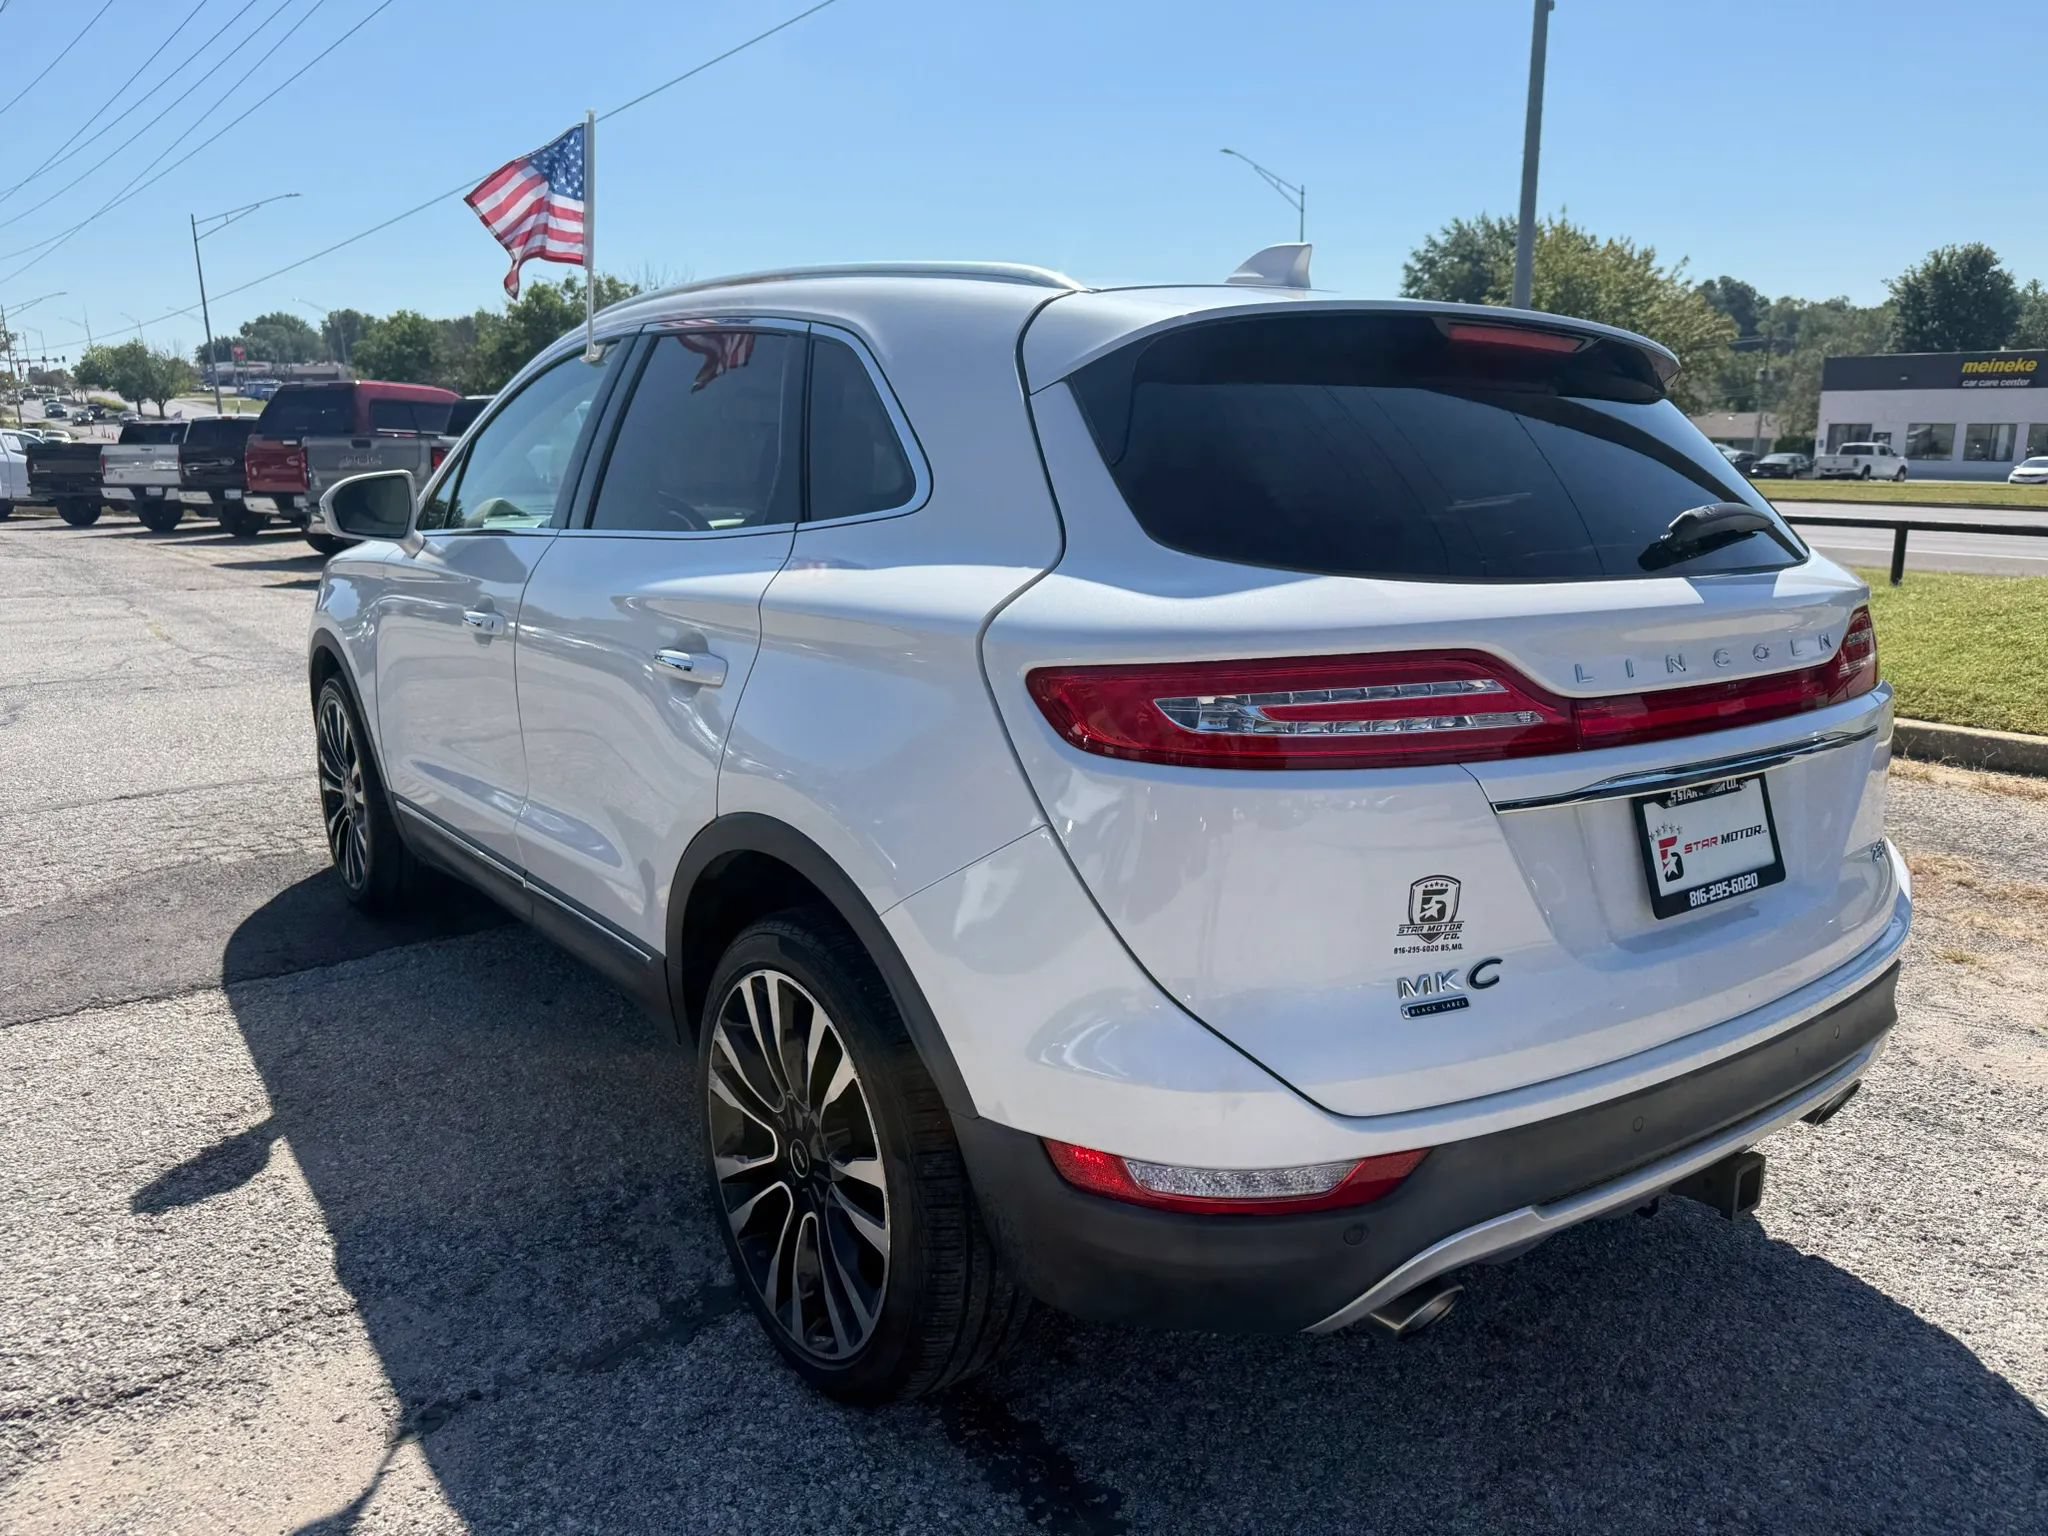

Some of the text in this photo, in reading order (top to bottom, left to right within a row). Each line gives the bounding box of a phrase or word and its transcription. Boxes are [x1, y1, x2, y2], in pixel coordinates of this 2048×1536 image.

[1961, 357, 2038, 374] meineke
[1962, 378, 2031, 387] car care center
[1574, 632, 1832, 684] LINCOLN
[1684, 836, 1718, 854] STAR
[1720, 825, 1762, 844] MOTOR
[1689, 872, 1758, 907] 816-295-6020
[1398, 923, 1463, 935] STAR MOTOR
[1396, 956, 1504, 1000] MKC
[1411, 1000, 1466, 1015] BLACK LABEL
